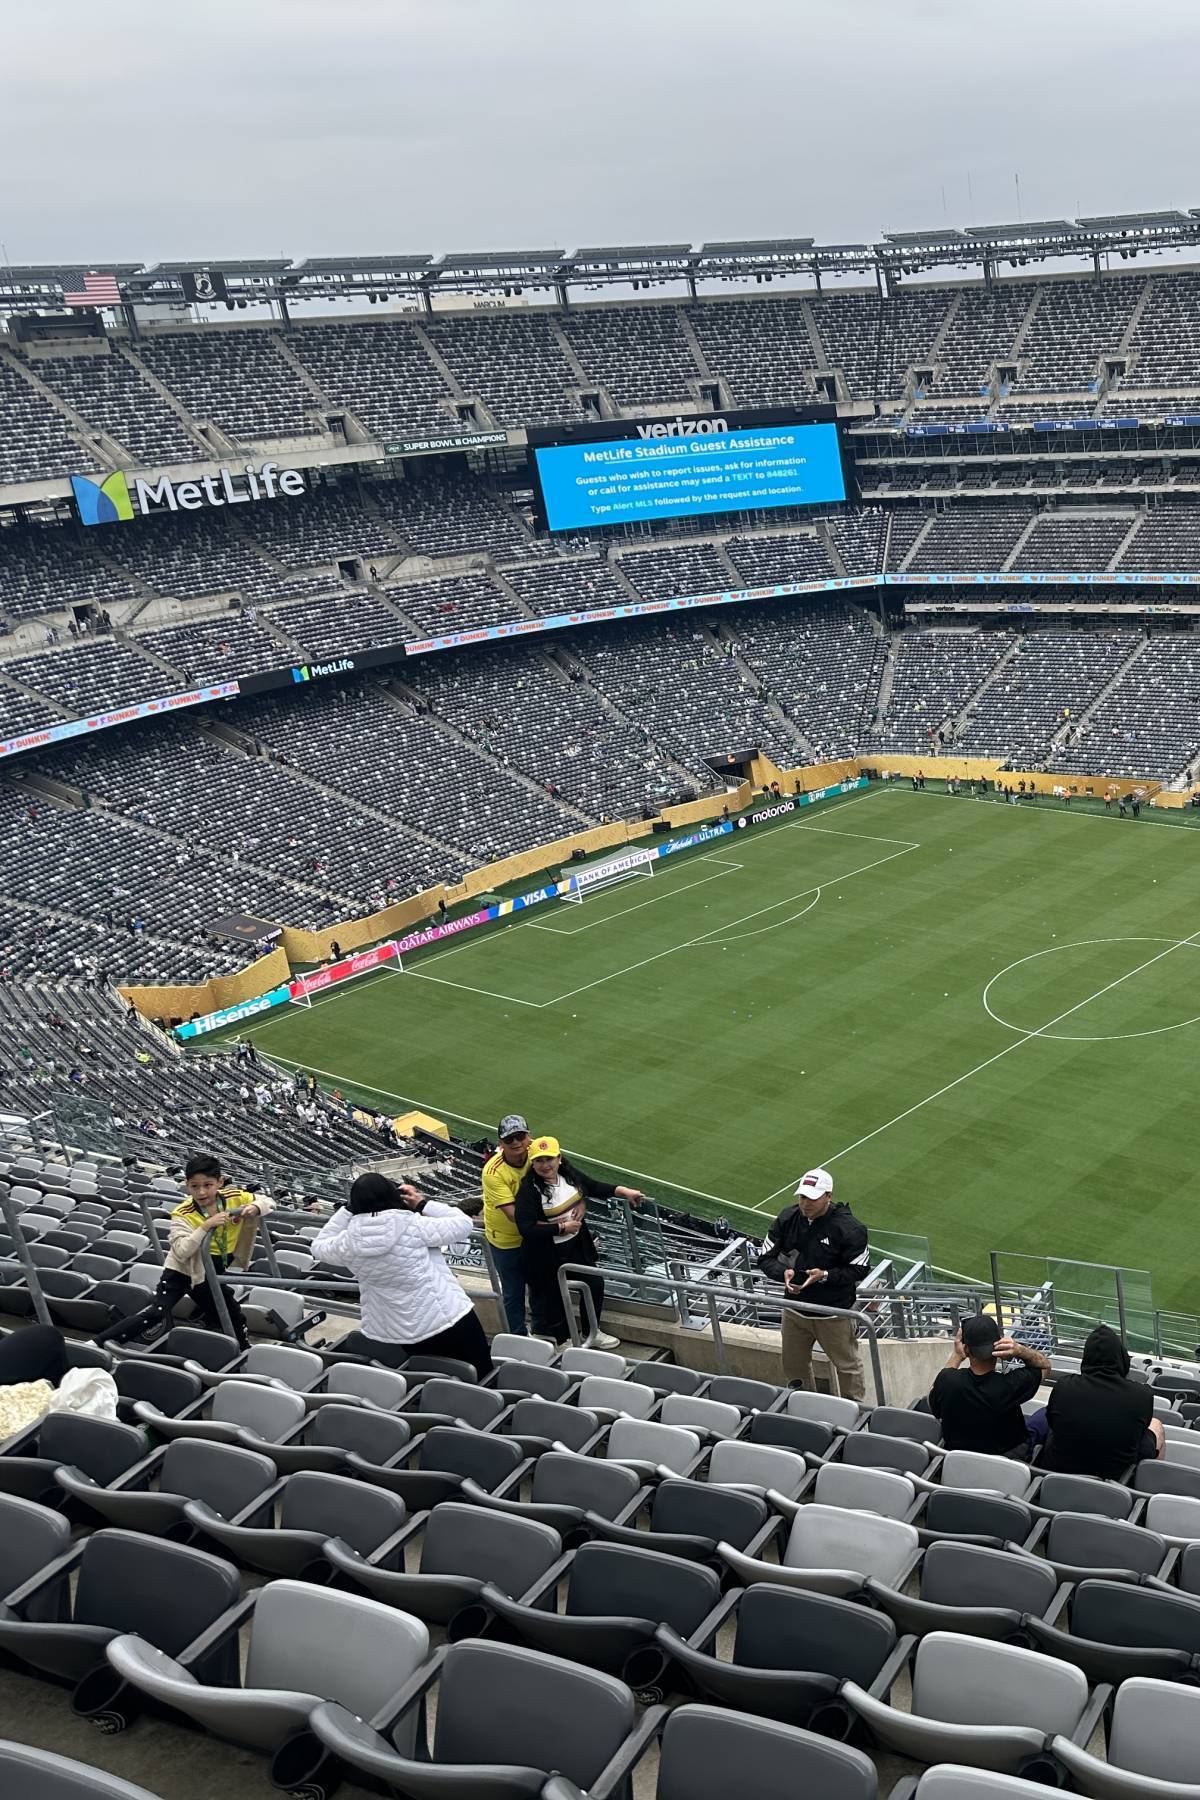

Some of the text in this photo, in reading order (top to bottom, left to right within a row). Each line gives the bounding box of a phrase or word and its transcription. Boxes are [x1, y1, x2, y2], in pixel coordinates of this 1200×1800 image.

[636, 417, 728, 439] verizon
[403, 442, 428, 451] SUPER
[430, 440, 455, 449] BOWL
[462, 434, 506, 445] CHAMPIONS
[584, 436, 795, 462] MetLife Stadium Guest Assistance
[576, 456, 807, 485] Guests who wish to report issues, ask for information
[135, 462, 305, 514] MetLife
[588, 488, 599, 496] or
[600, 485, 617, 495] call
[618, 484, 632, 493] for
[633, 480, 680, 491] assistance
[681, 478, 701, 487] may
[702, 475, 723, 484] send
[732, 472, 753, 480] TEXT
[591, 505, 611, 514] Type
[654, 496, 691, 505] followed
[692, 495, 702, 503] by
[719, 490, 750, 499] request
[751, 488, 767, 496] and
[311, 659, 354, 677] MetLife
[752, 801, 795, 824] motorola
[699, 827, 726, 840] ULTRA
[578, 855, 647, 884] BANK OF AMERICA
[522, 888, 548, 906] VISA
[400, 913, 481, 951] QATAR AIRWAYS
[194, 997, 272, 1036] Hisense
